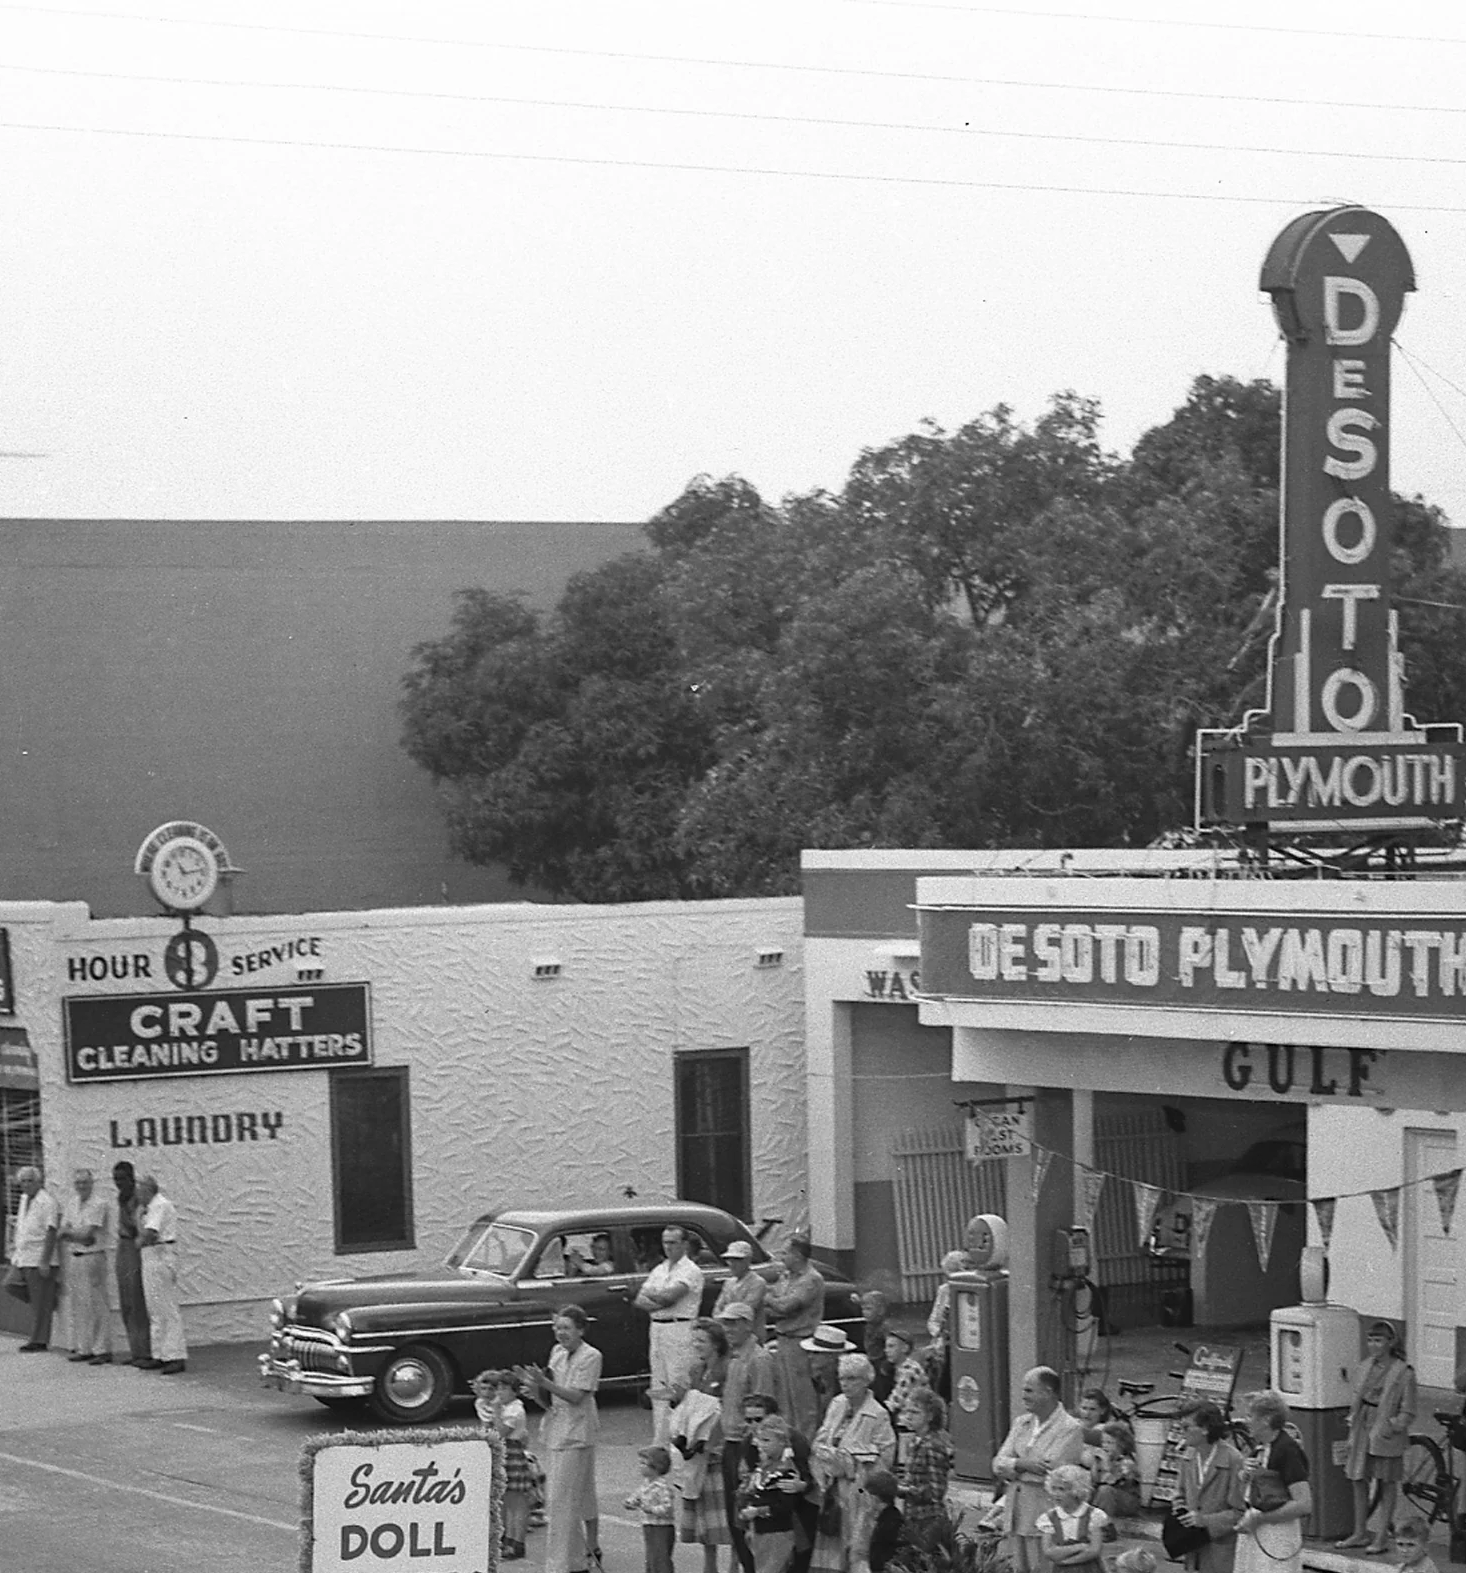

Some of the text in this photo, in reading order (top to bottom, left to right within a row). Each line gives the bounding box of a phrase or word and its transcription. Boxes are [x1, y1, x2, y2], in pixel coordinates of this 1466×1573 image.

[1321, 275, 1382, 734] DESOTO
[1243, 754, 1455, 808] PLYMOUTH
[68, 953, 152, 982] HOUR
[232, 937, 321, 976] SERVICE
[130, 997, 314, 1039] CRAFT
[77, 1032, 363, 1071] CLEANING HATTERS
[1223, 1041, 1376, 1096] GULF
[110, 1111, 284, 1149] LAUNDRY
[343, 1460, 466, 1510] Santa's
[340, 1521, 456, 1561] DOLL
